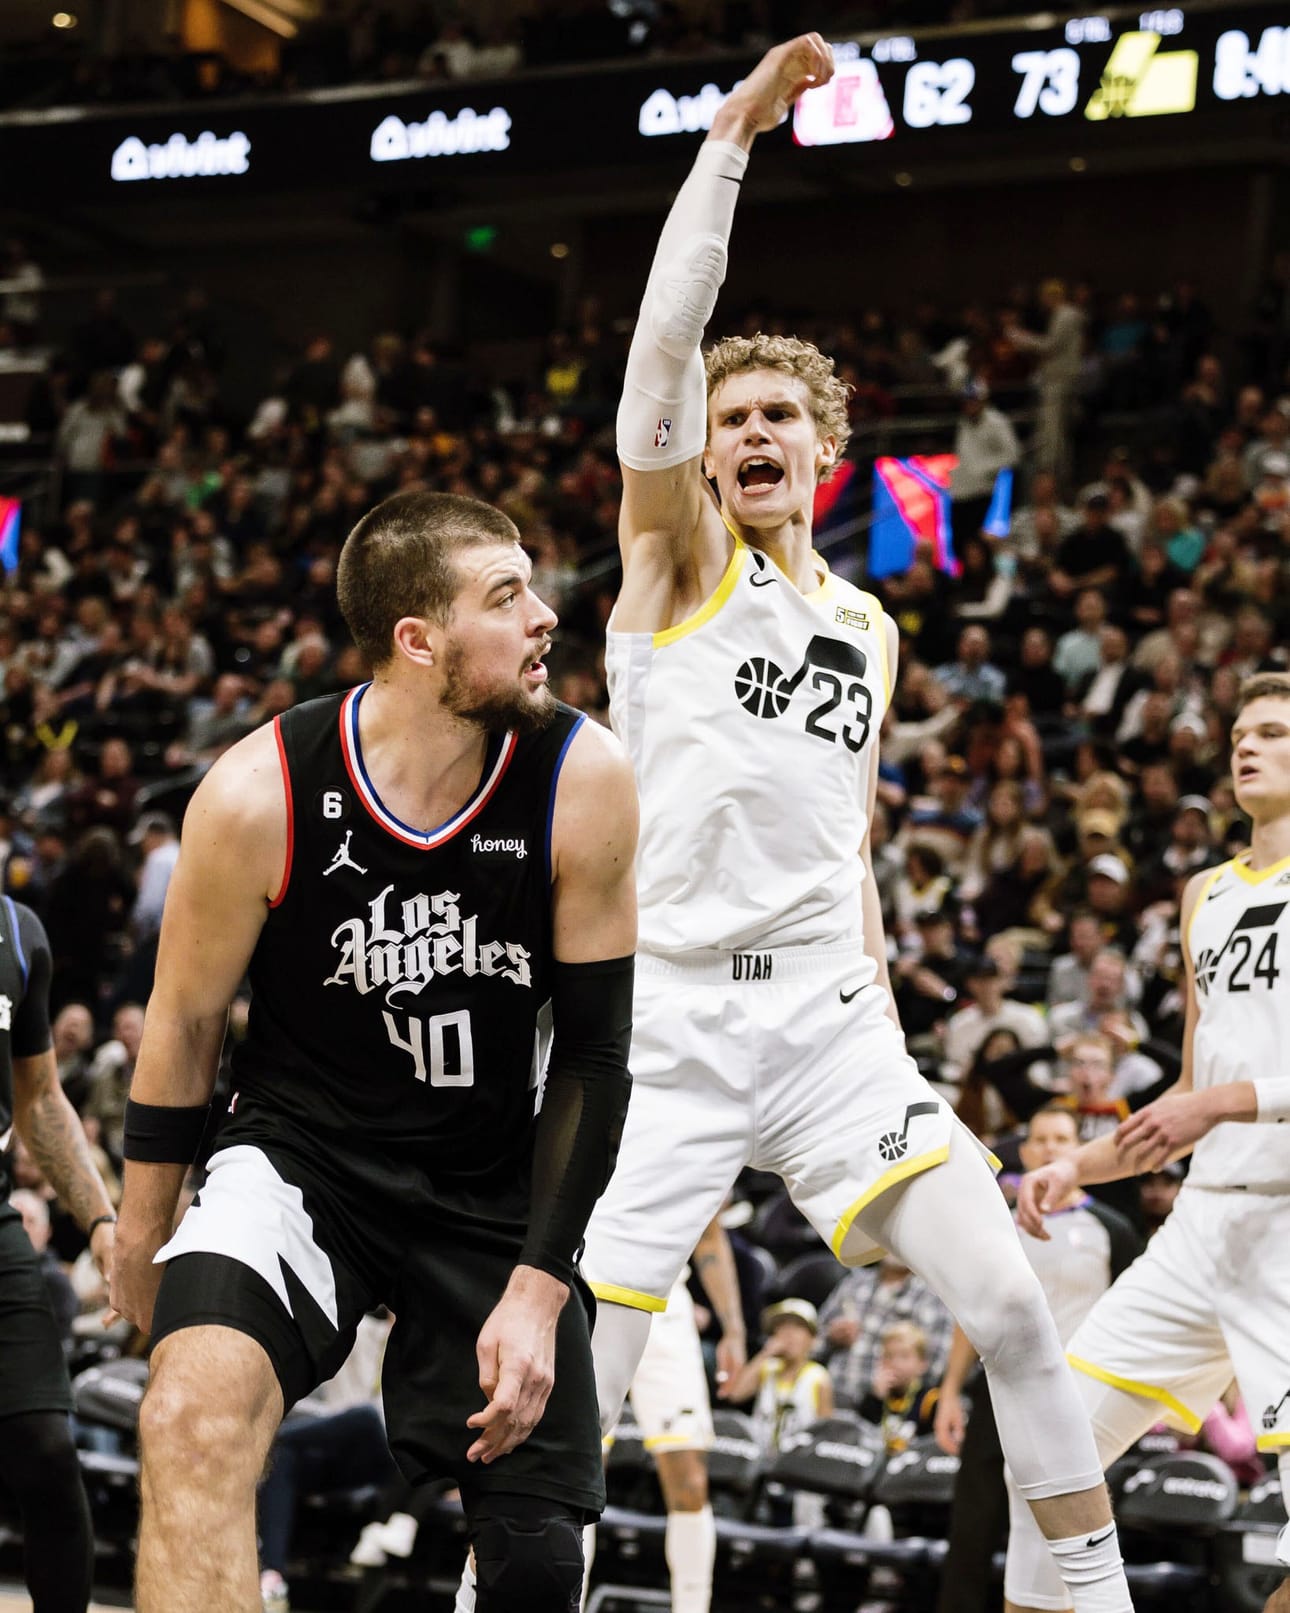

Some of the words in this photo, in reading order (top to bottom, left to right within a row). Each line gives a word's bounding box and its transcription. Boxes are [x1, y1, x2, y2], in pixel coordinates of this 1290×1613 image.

[903, 58, 976, 128] 62
[1012, 48, 1081, 118] 73
[805, 671, 873, 754] 23
[323, 792, 343, 819] 6
[471, 834, 528, 859] honey
[365, 884, 462, 947] Los
[322, 913, 532, 1010] Angeles
[732, 954, 772, 981] UTAH
[1227, 932, 1280, 993] 24
[381, 1009, 474, 1087] 40
